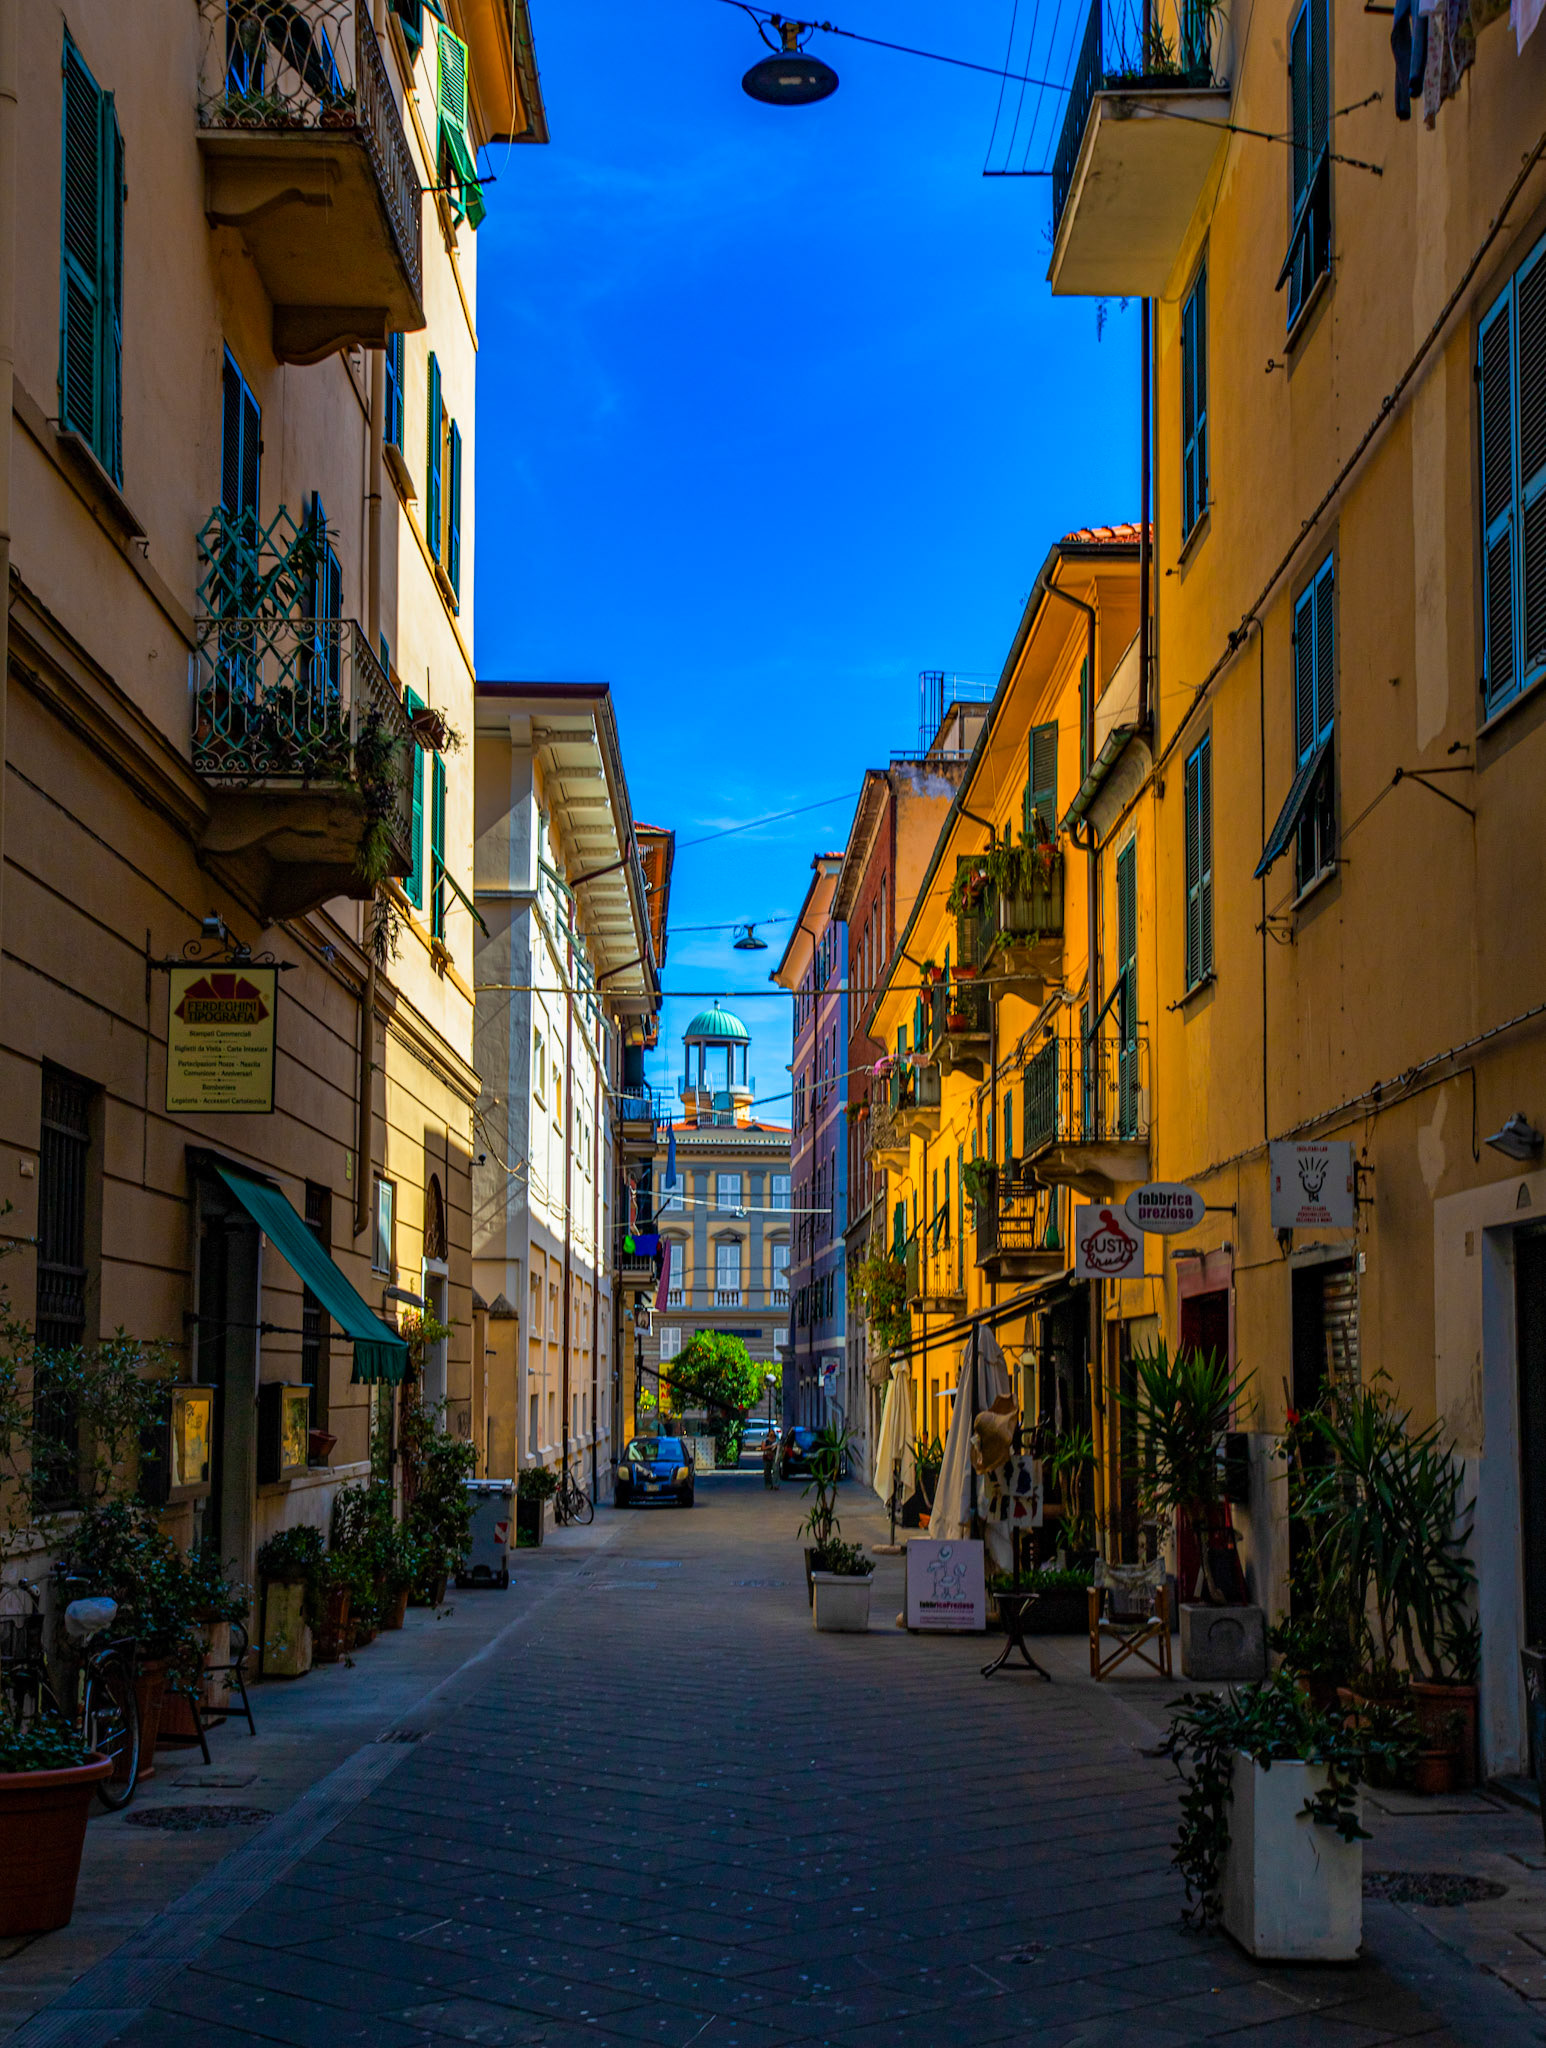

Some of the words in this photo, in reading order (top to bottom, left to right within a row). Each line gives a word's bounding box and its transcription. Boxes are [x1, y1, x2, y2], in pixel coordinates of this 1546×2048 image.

[187, 1001, 257, 1011] FERDEGHINI
[188, 1011, 255, 1022] TIPOGRAFIA
[189, 1030, 215, 1038] Stampati
[216, 1030, 252, 1038] Commerciali
[174, 1045, 197, 1053] Biglietti
[206, 1045, 222, 1053] Visita
[227, 1045, 242, 1053] Carte
[243, 1045, 268, 1053] Intestate
[178, 1060, 217, 1068] Partecipazioni
[218, 1060, 235, 1068] Nozze
[240, 1060, 261, 1068] Nascita
[171, 1097, 198, 1105] Legatoria
[203, 1097, 230, 1105] Accessori
[231, 1097, 267, 1105] Cartotecnica
[1138, 1192, 1192, 1206] fabbrica
[1138, 1206, 1194, 1219] prezioso
[1080, 1238, 1138, 1253] GUSTO
